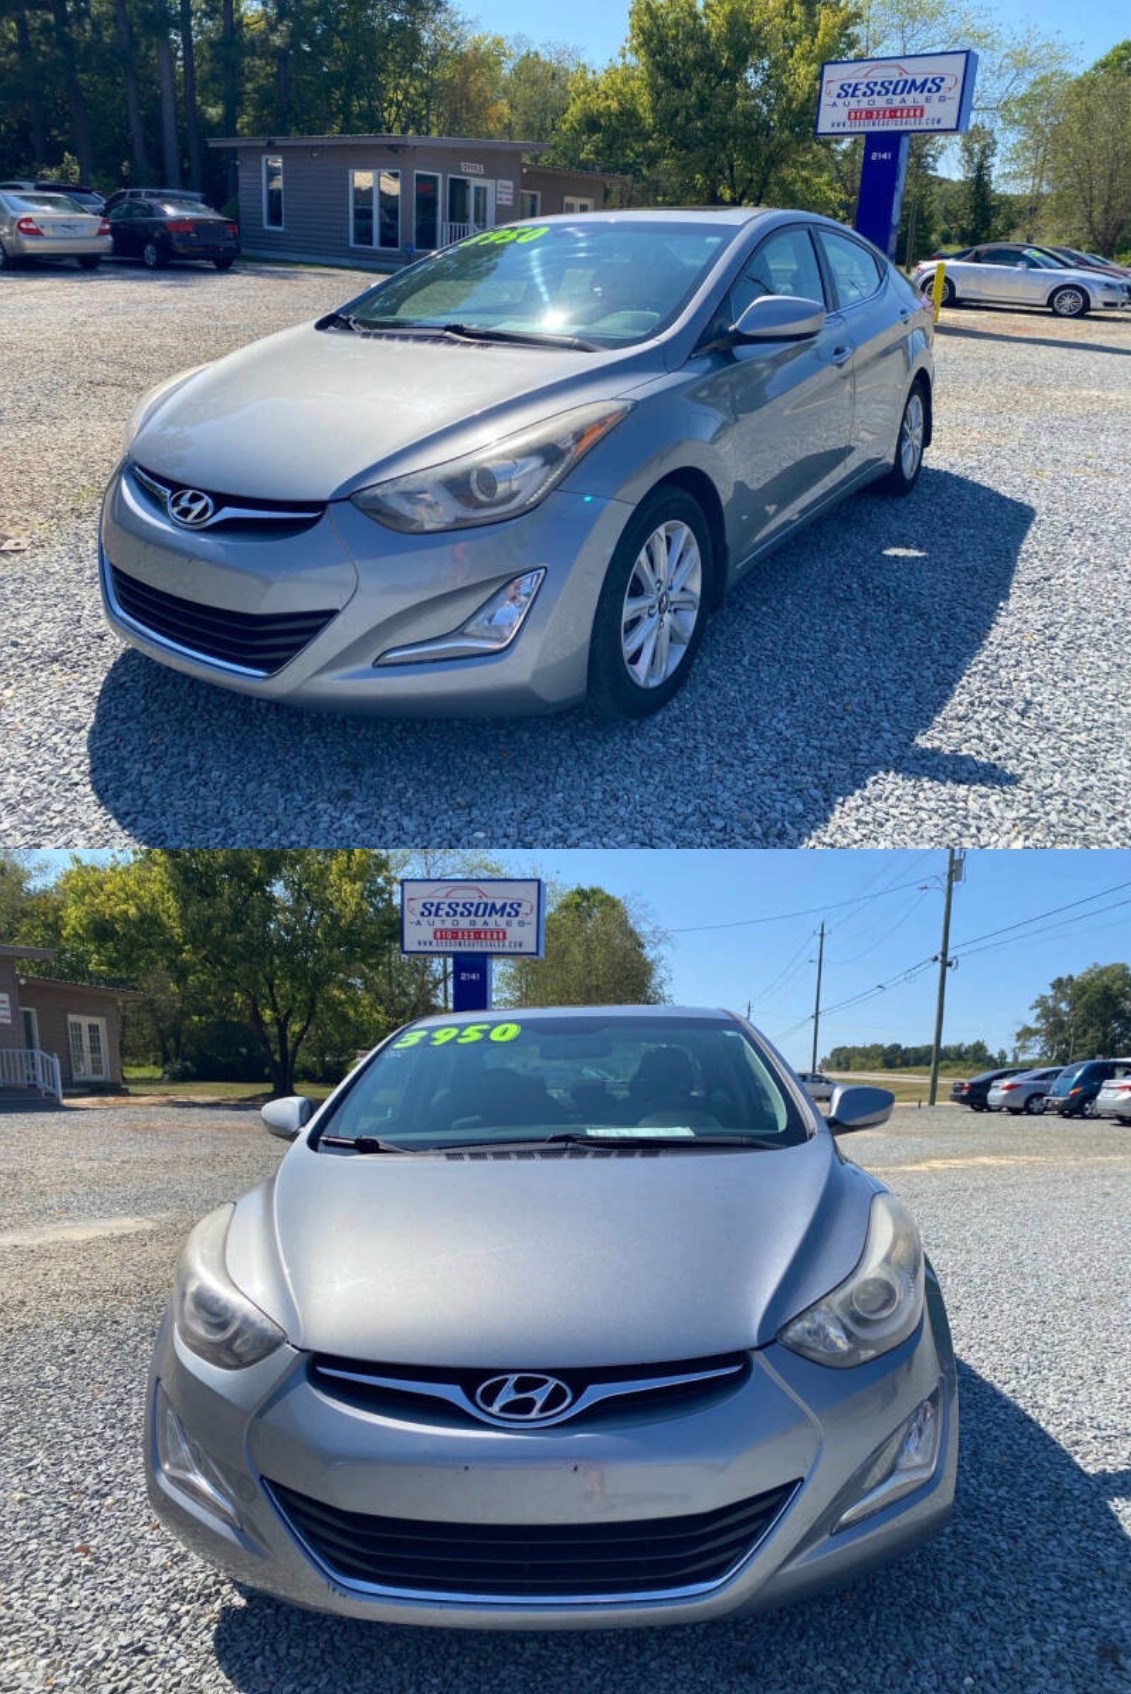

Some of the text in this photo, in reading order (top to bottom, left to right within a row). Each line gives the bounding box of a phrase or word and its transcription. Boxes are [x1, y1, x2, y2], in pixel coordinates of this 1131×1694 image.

[837, 77, 945, 99] SESSOMS
[831, 96, 946, 107] AUTO SALES
[871, 152, 891, 161] 2141
[420, 902, 522, 918] SESSOMS
[415, 919, 526, 927] AUTO SALES
[460, 973, 480, 981] 2141
[393, 1023, 521, 1049] 3950
